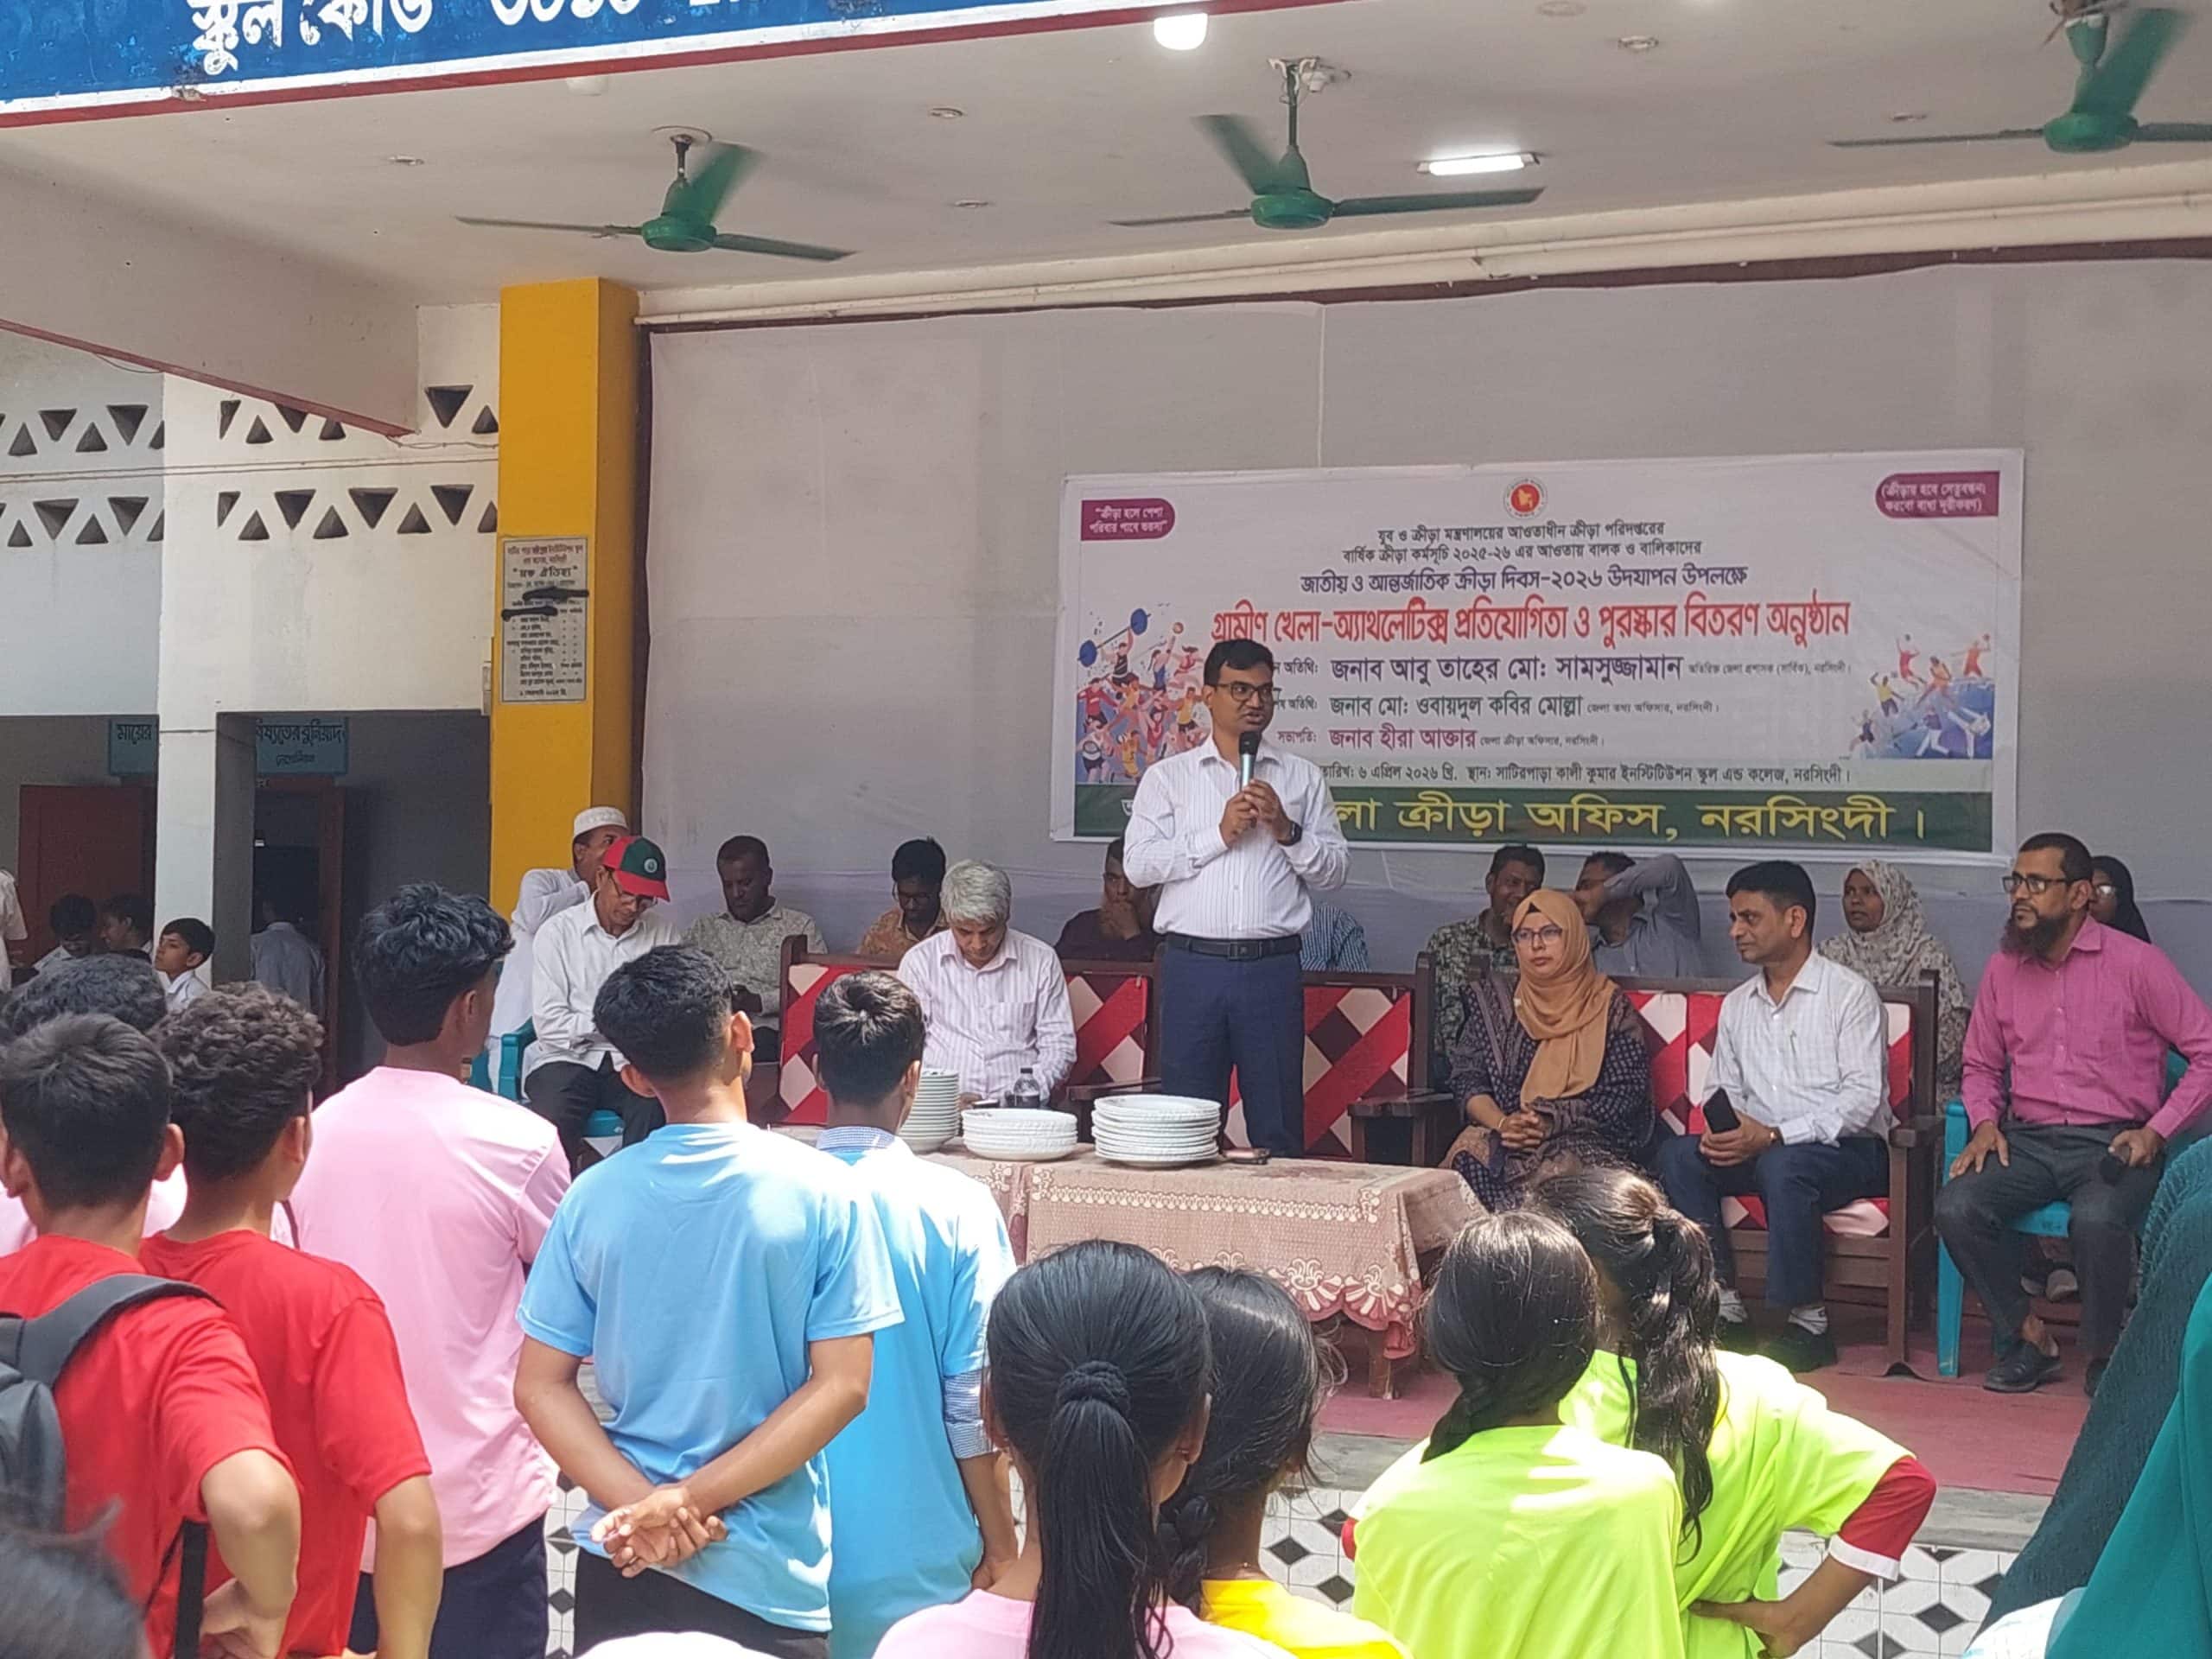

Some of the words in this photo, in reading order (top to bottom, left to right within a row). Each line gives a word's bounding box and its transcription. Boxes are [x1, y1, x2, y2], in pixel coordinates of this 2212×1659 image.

[1376, 530, 1395, 546] যুব
[1398, 530, 1408, 542] ও
[1410, 524, 1441, 544] ক্রীড়া
[1506, 519, 1567, 540] আওতাধীন
[1569, 519, 1601, 540] ক্রীড়া
[1605, 518, 1666, 537] পরিদপ্তরের
[1341, 545, 1376, 563] বার্ষিক
[1378, 544, 1408, 565] ক্রীড়া
[1411, 543, 1450, 566] কর্মসূচি
[1452, 545, 1511, 563] ২০২৫-২৬
[1515, 544, 1535, 559] এর
[1536, 543, 1586, 558] আওতায়
[1587, 543, 1622, 557] বালক
[1625, 543, 1636, 556] ও
[1638, 537, 1703, 556] বালিকাদের
[1300, 569, 1349, 594] জাতীয়
[1351, 575, 1364, 593] ও
[1368, 566, 1451, 594] আন্তর্জাতিক
[1453, 565, 1497, 593] ক্রীড়া
[1500, 564, 1603, 590] দিবস-২০২৬
[1607, 563, 1678, 588] উদযাপন
[1681, 562, 1749, 586] উপলক্ষে
[1211, 598, 1269, 642] গ্রামীণ
[1453, 594, 1569, 641] প্রতিযোগিতা
[1573, 606, 1591, 639] ও
[1598, 604, 1679, 650] পুরস্কার
[1683, 590, 1761, 637] বিতরণ
[1765, 588, 1852, 649] অনুষ্ঠান
[1330, 657, 1386, 683] জনাব
[1389, 656, 1432, 687] আবু
[1435, 656, 1501, 684] তাহের
[1554, 653, 1685, 686] সামসুজ্জামান
[1329, 697, 1373, 717] জনাব
[1415, 696, 1484, 721] ওবায়দুল
[1487, 690, 1533, 716] কবির
[1537, 695, 1584, 718] মোল্লা
[1328, 728, 1375, 749] জনাব
[1379, 722, 1415, 751] হীরা
[1420, 728, 1478, 749] আক্তার
[1357, 766, 1368, 779] ৬
[1370, 761, 1402, 780] এপ্রিল
[1405, 766, 1439, 781] ২০২৬
[1496, 762, 1552, 784] সাটিরপাড়া
[1555, 761, 1583, 782] কালী
[1586, 766, 1618, 785] কুমার
[1620, 762, 1693, 783] ইনস্টিটিউশন
[1696, 767, 1719, 785] স্কুল
[1747, 767, 1789, 785] কলেজ,
[1793, 763, 1842, 784] নরসিংদী
[1335, 797, 1382, 830] লা
[1393, 790, 1512, 837] ক্রীড়া
[1523, 792, 1678, 842] অফিস,
[1696, 794, 1897, 841] নরসিংদী
